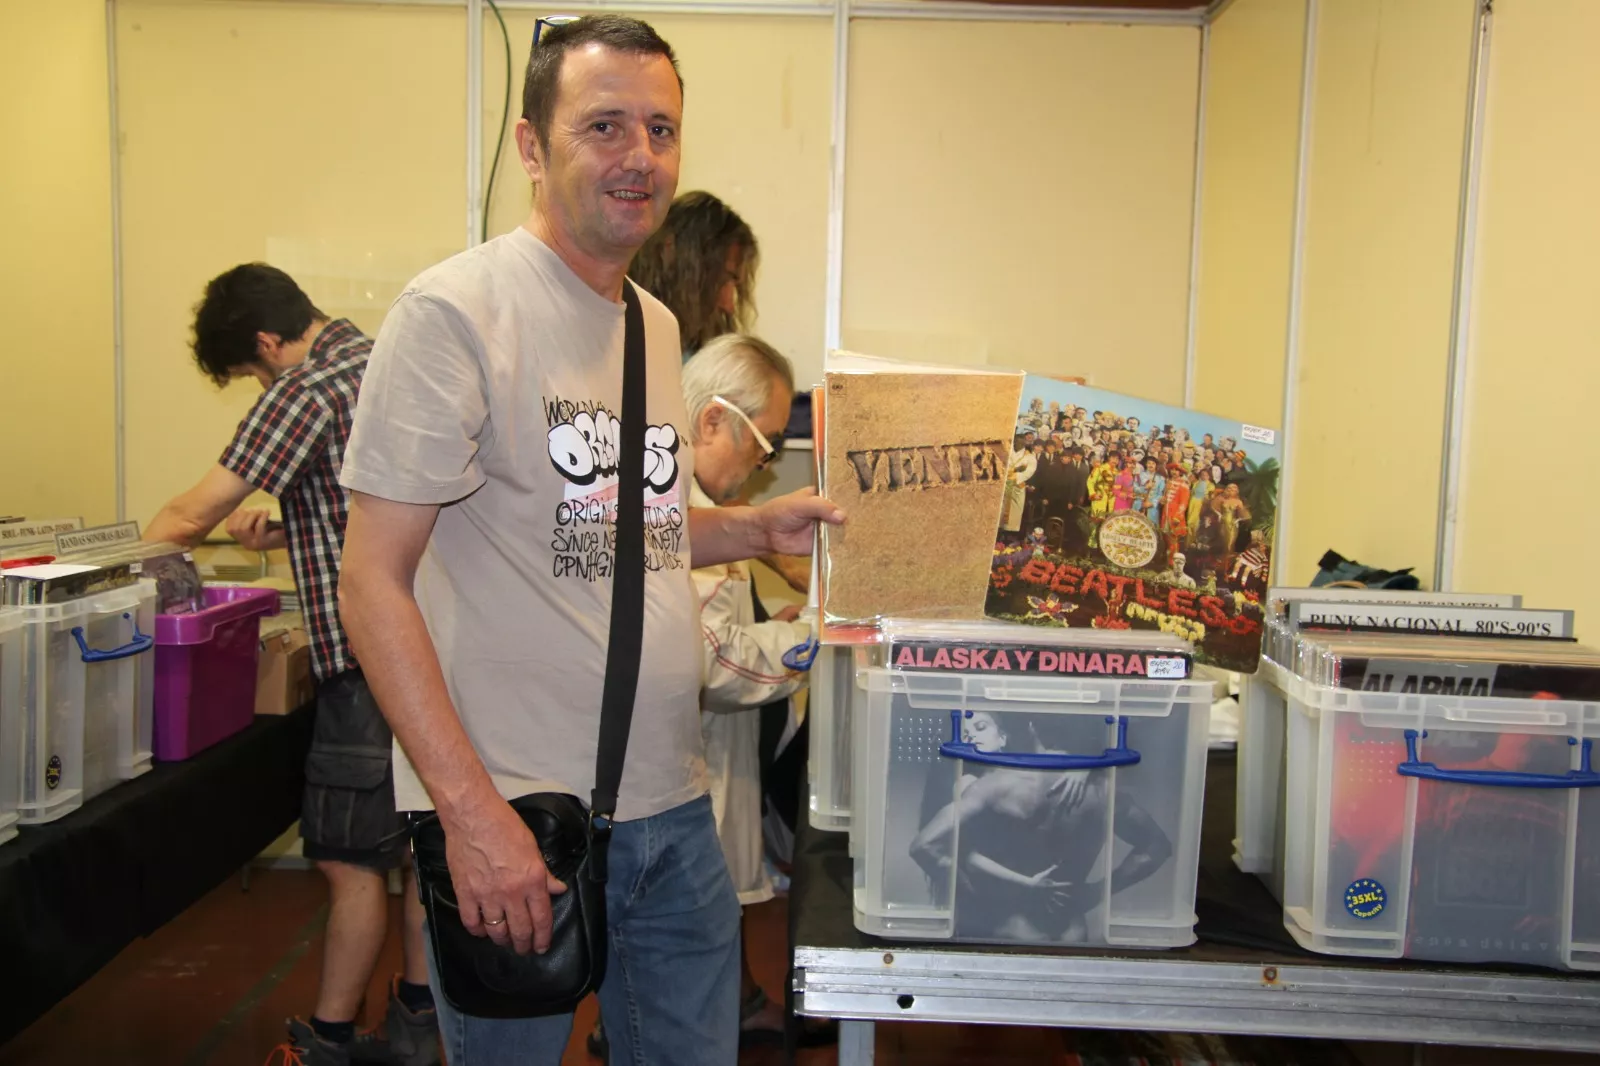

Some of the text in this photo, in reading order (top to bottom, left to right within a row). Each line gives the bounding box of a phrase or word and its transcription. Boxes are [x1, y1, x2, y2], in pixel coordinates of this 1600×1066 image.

[1019, 558, 1228, 627] BEATLES
[1310, 614, 1361, 627] PUNK
[1367, 616, 1467, 632] NACIONAL
[896, 646, 1187, 675] ALASKA Y DINARA
[1352, 892, 1379, 905] 35XL
[1353, 904, 1382, 918] Capacity
